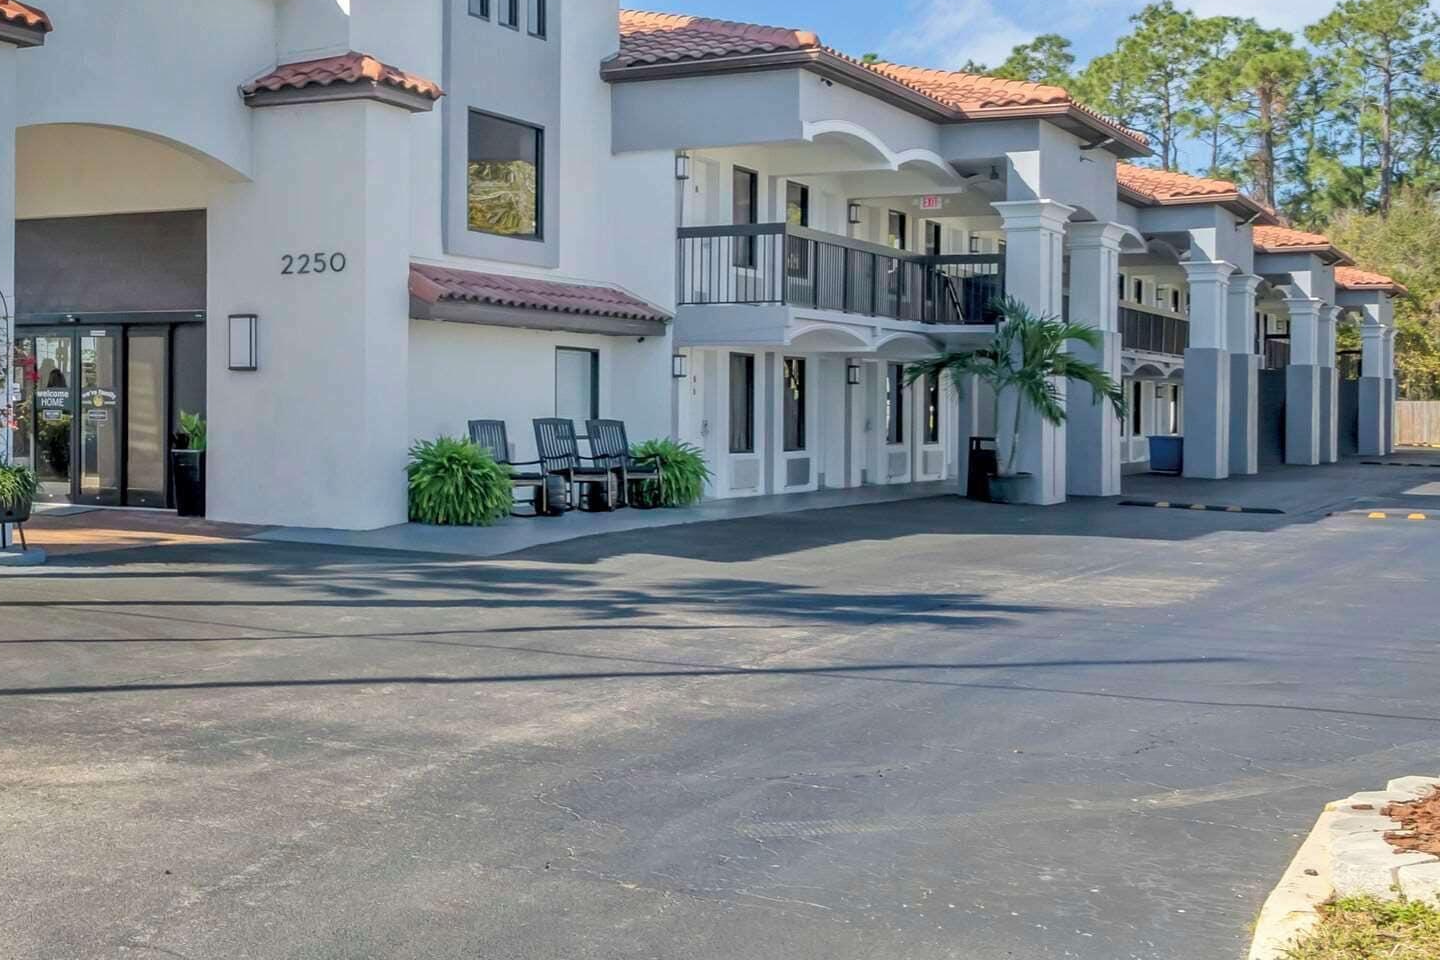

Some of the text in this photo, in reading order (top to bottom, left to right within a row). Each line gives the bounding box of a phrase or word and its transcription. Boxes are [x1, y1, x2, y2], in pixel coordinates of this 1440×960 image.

[281, 251, 346, 275] 2250
[36, 389, 69, 398] welcome
[41, 398, 65, 407] HOME
